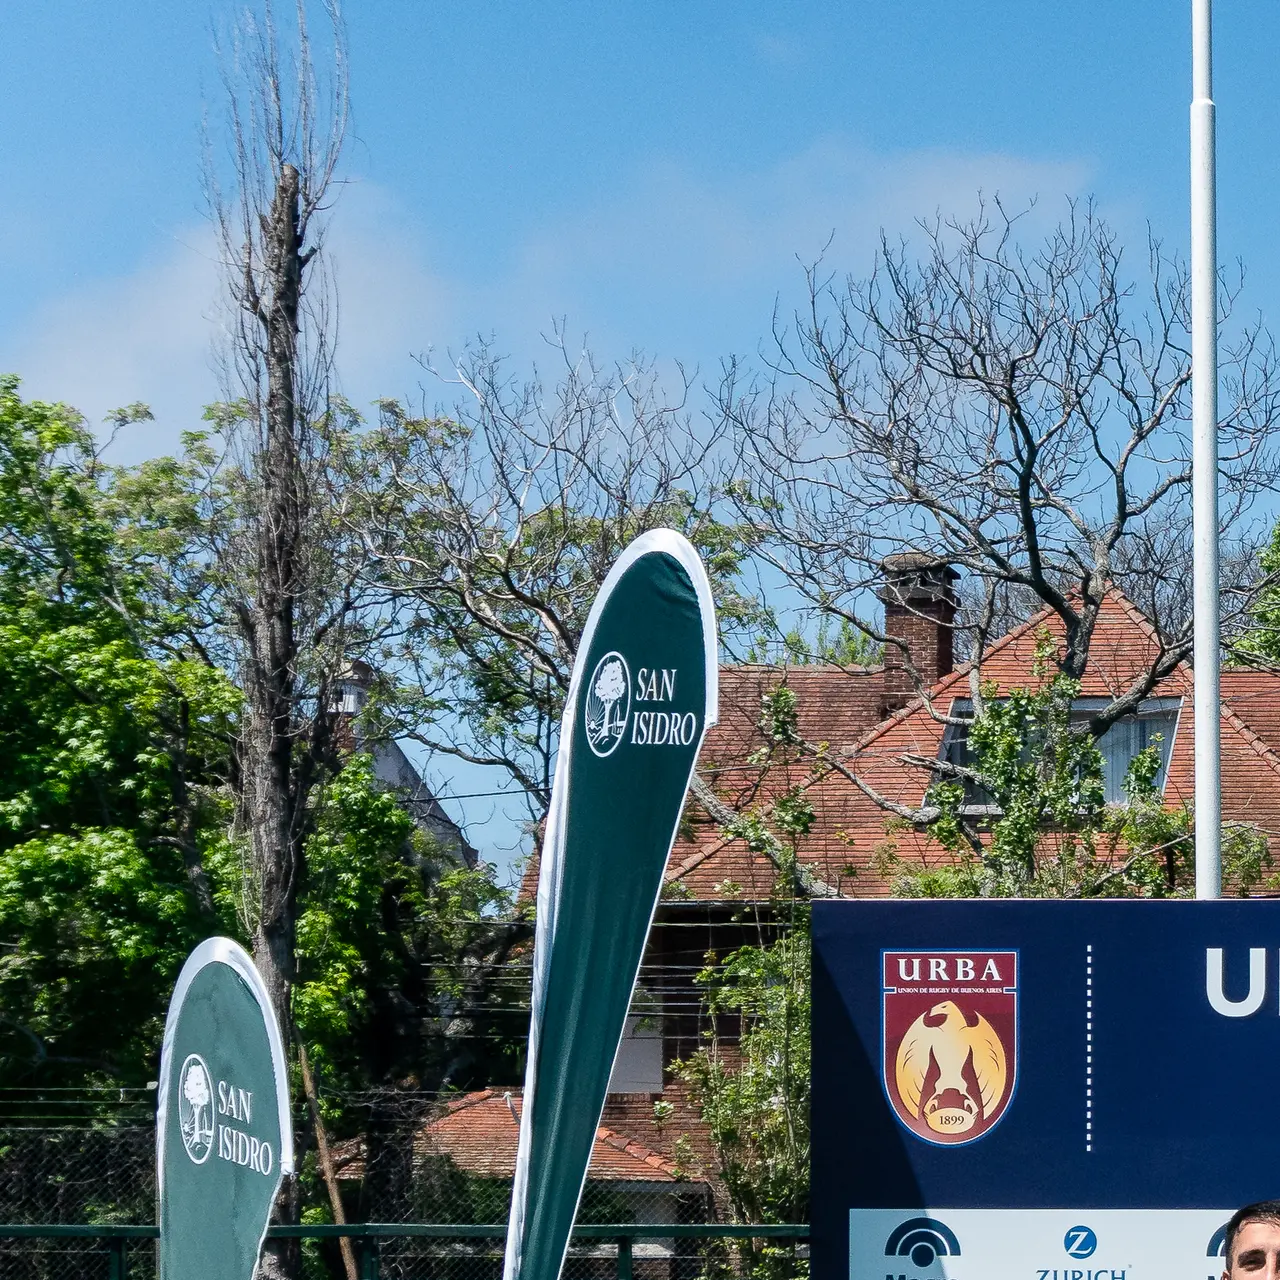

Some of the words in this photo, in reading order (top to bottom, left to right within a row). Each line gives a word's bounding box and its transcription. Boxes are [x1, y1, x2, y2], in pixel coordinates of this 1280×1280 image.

[636, 667, 677, 703] SAN
[629, 711, 697, 747] ISIDRO
[896, 957, 1003, 982] URBA
[217, 1080, 254, 1122] SAN
[939, 1115, 965, 1126] 1899
[217, 1129, 273, 1177] ISIDRO
